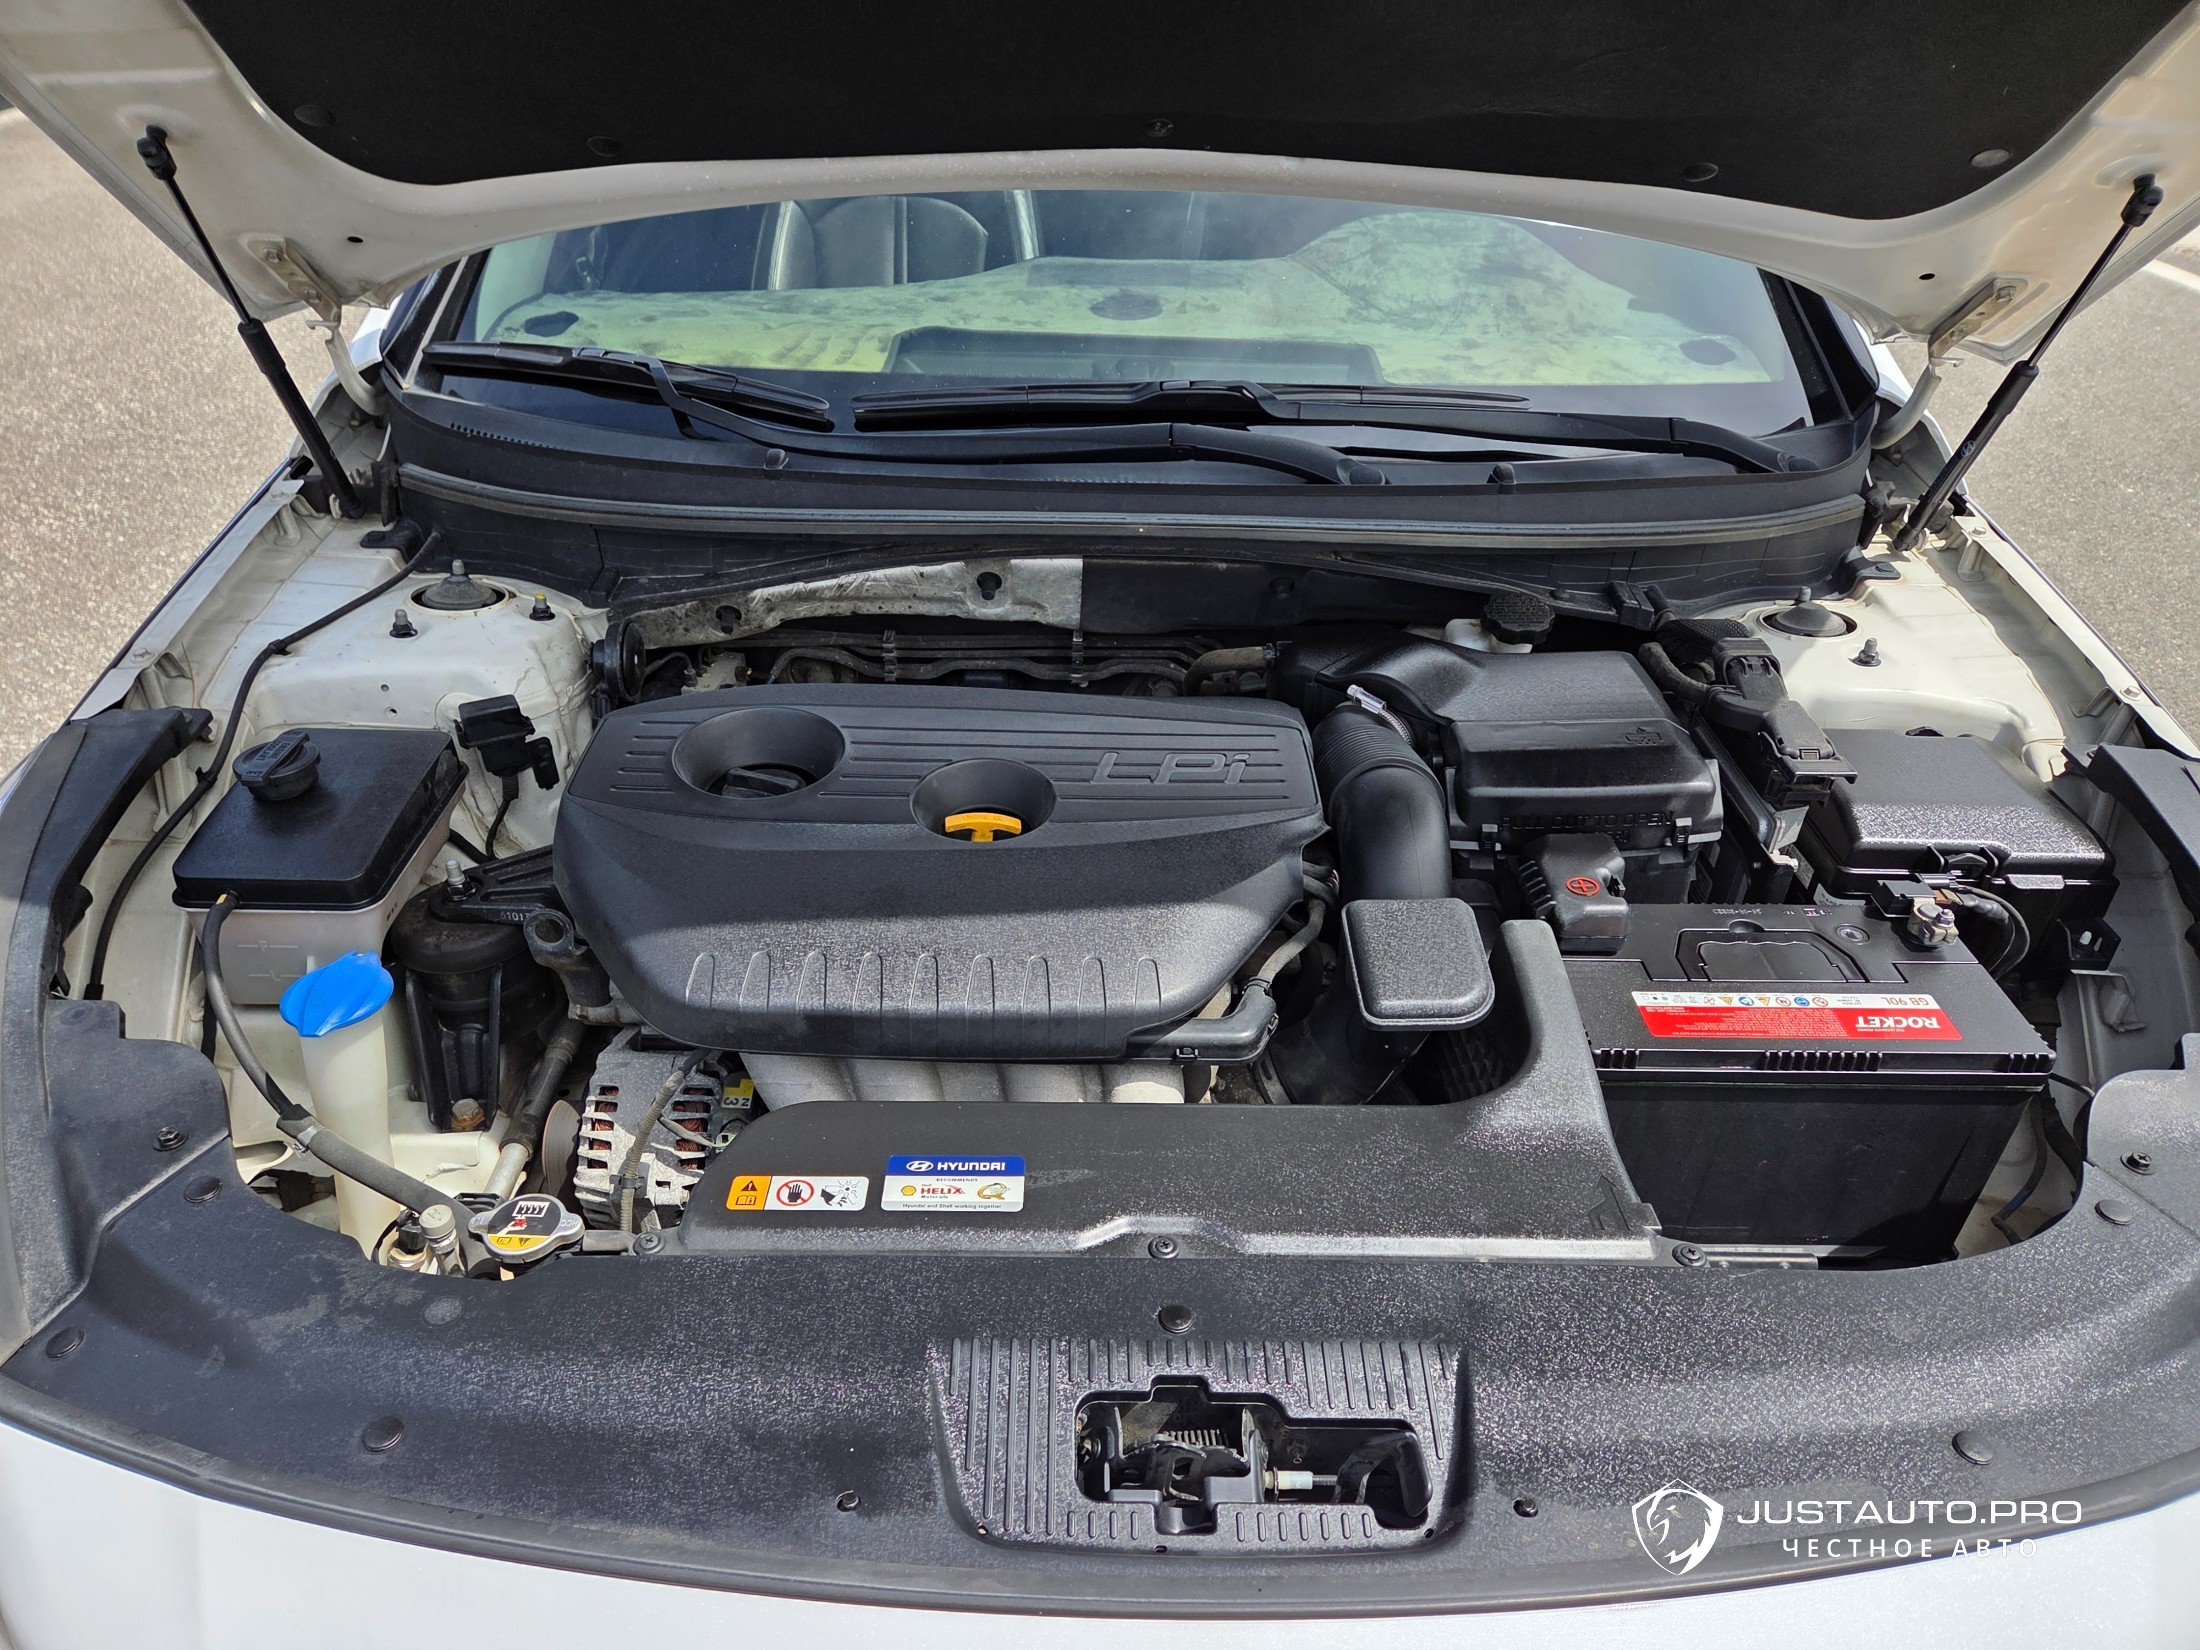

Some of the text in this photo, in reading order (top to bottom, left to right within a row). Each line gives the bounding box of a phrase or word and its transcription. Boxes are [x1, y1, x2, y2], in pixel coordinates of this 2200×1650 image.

[1090, 751, 1250, 785] LPi
[1501, 810, 1674, 829] PULL OUT TO OPEN
[1880, 996, 1929, 1006] GB 90L
[1855, 1016, 1941, 1028] ROCKET
[724, 1097, 739, 1106] 3
[937, 1162, 1006, 1171] HYUNDAI
[920, 1187, 966, 1195] HELIX
